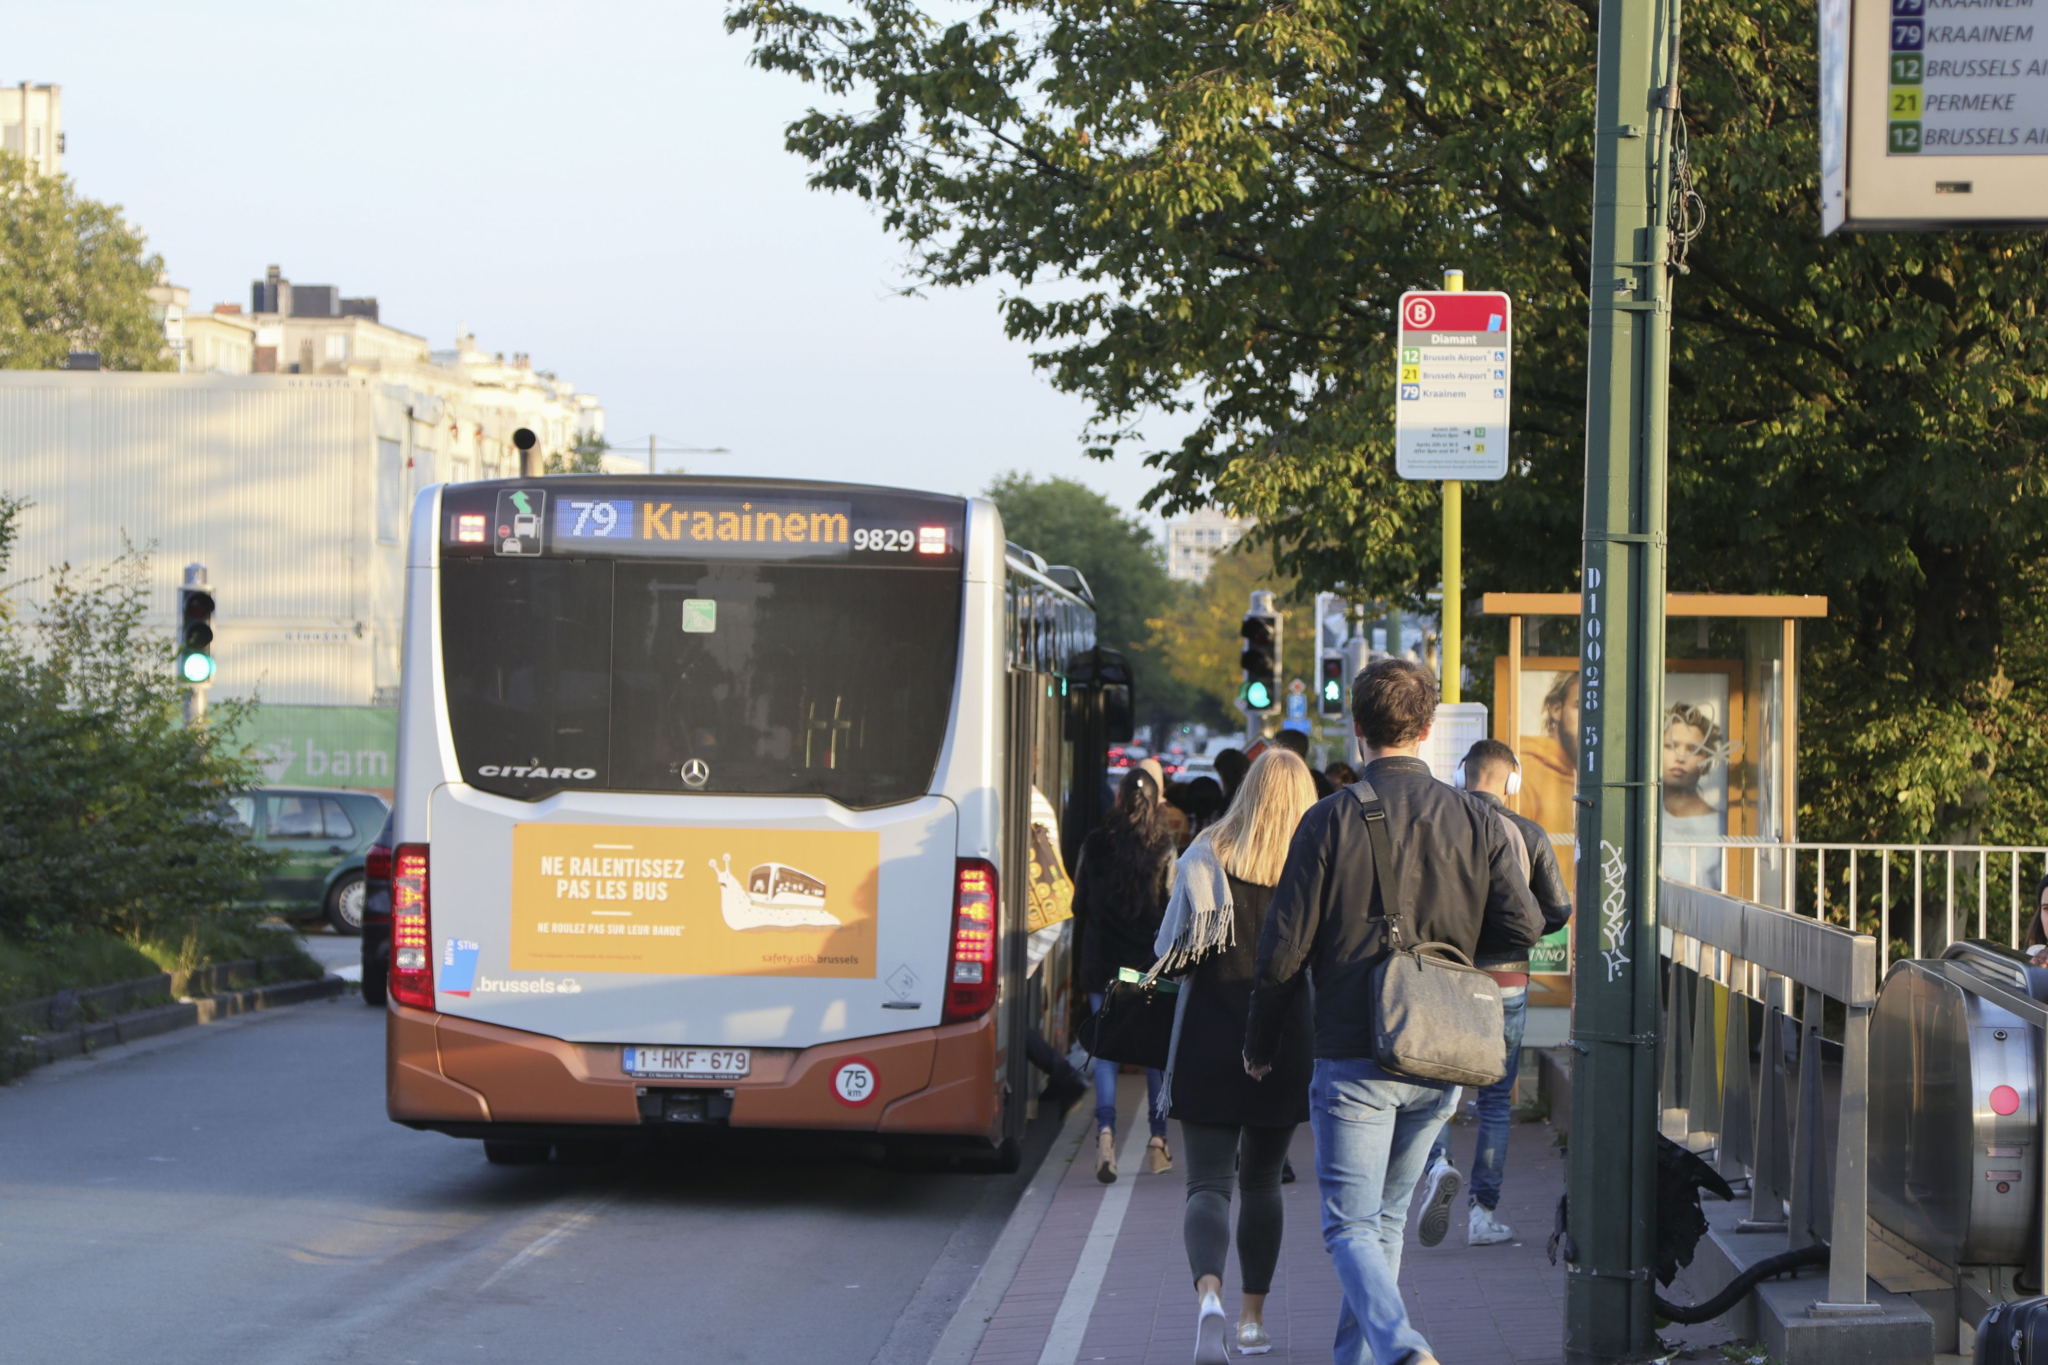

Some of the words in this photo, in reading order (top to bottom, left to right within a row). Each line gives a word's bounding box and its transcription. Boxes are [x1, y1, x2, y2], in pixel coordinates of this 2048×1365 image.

[1895, 26, 1921, 43] 79
[1927, 25, 2034, 42] KRAAINEM
[1894, 60, 1919, 78] 12
[1926, 59, 2021, 77] BRUSSELS
[2026, 59, 2048, 76] AI
[1893, 94, 1918, 112] 21
[1925, 93, 2016, 111] PERMEKE
[1893, 128, 1918, 147] 12
[1924, 127, 2020, 145] BRUSSELS
[2024, 127, 2048, 145] AI
[1414, 304, 1427, 322] B
[1431, 334, 1477, 345] Diamant
[1403, 351, 1419, 362] 12
[1423, 353, 1456, 361] Brussels
[1458, 353, 1487, 363] Airport
[1403, 369, 1418, 380] 21
[1423, 372, 1456, 380] Brussels
[1458, 372, 1487, 382] Airport
[1402, 386, 1419, 399] 79
[1423, 389, 1466, 398] Kraainem
[571, 502, 618, 537] 79
[643, 502, 848, 543] Kraainem
[853, 528, 915, 552] 9829
[305, 738, 389, 777] bam
[478, 765, 597, 780] CITARO
[541, 856, 565, 876] NE
[569, 857, 685, 879] RALENTISSEZ
[556, 879, 591, 899] PAS
[596, 880, 627, 900] LES
[633, 881, 668, 901] BUS
[537, 922, 549, 933] NE
[551, 922, 585, 934] ROULEZ
[588, 923, 605, 935] PAS
[607, 924, 625, 935] SUR
[627, 924, 649, 936] LEUR
[1529, 947, 1565, 962] INNO
[843, 1070, 867, 1089] 75
[847, 1088, 862, 1097] km
